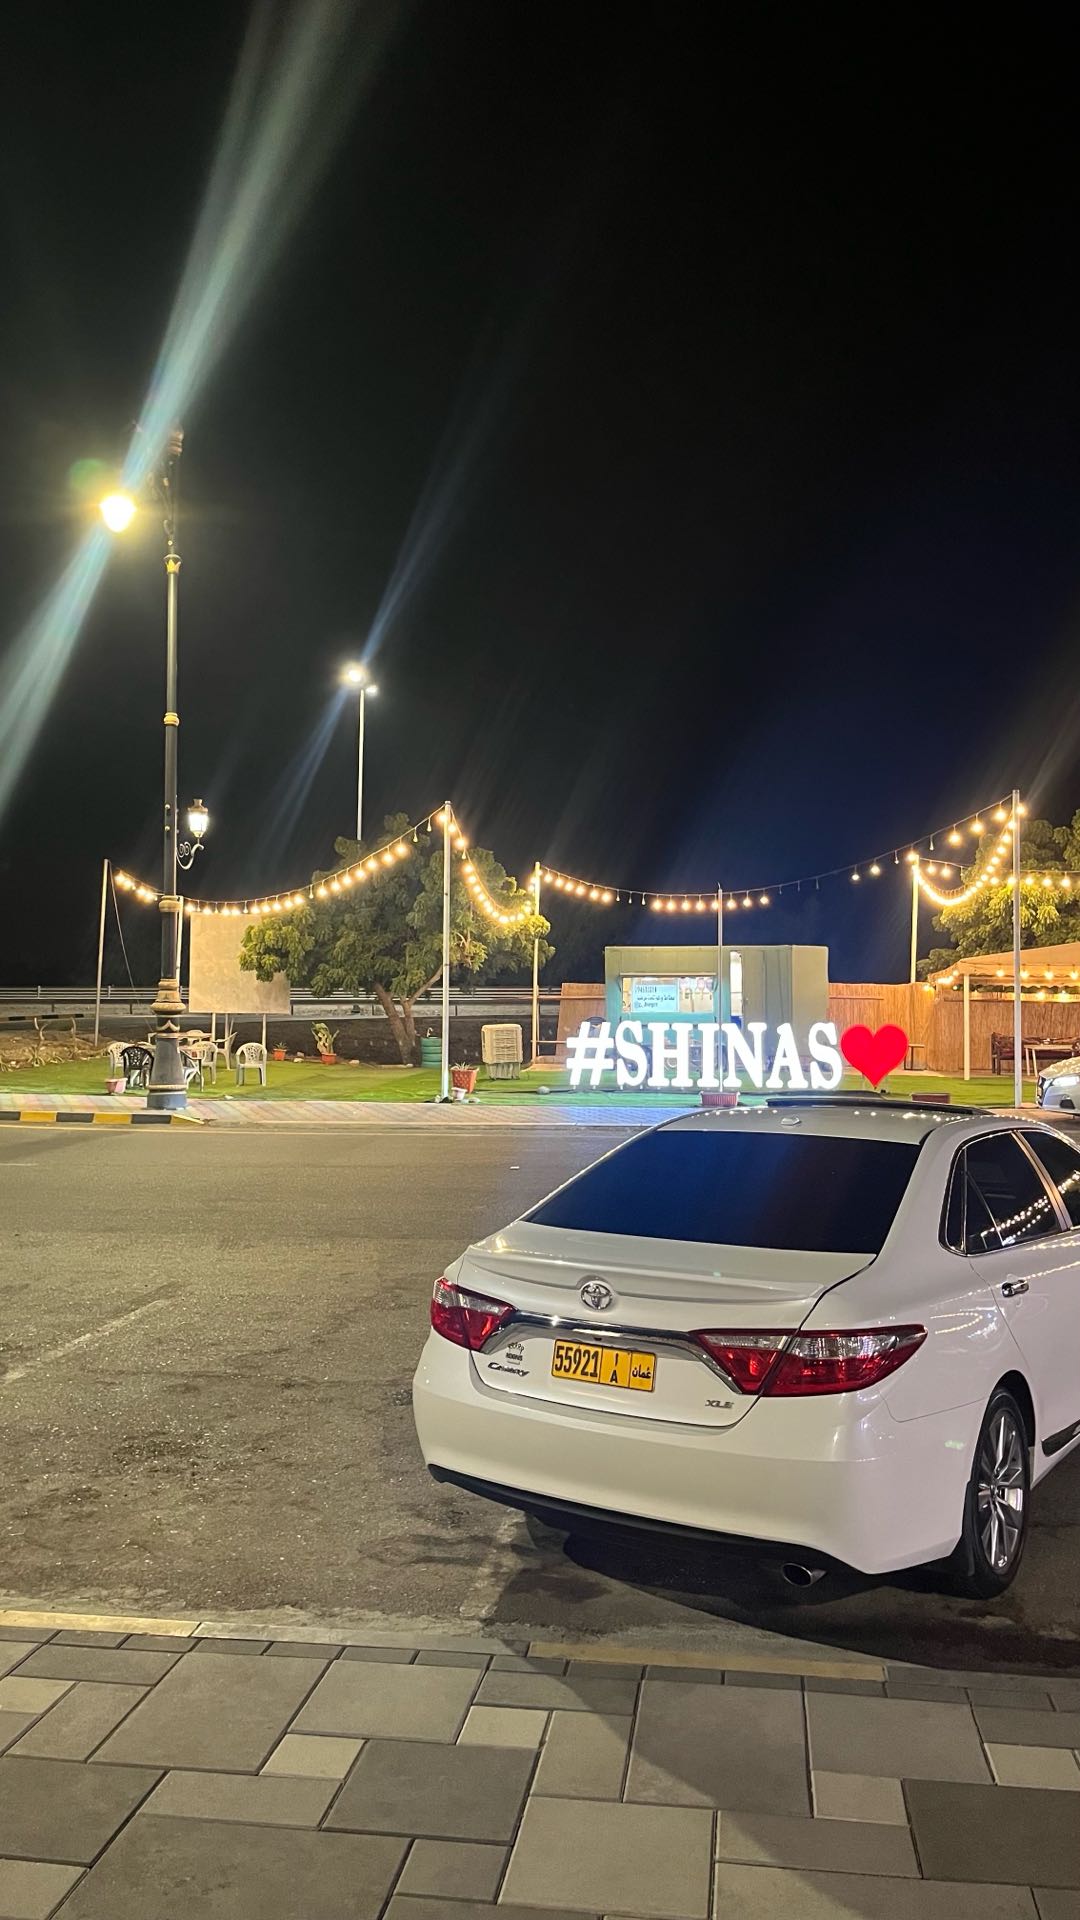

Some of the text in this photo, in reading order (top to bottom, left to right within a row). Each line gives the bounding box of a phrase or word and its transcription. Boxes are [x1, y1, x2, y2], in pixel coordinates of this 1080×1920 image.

[566, 1020, 843, 1088] #SHINAS
[554, 1345, 599, 1378] 55921
[609, 1369, 618, 1384] A
[704, 1399, 734, 1409] XLE
